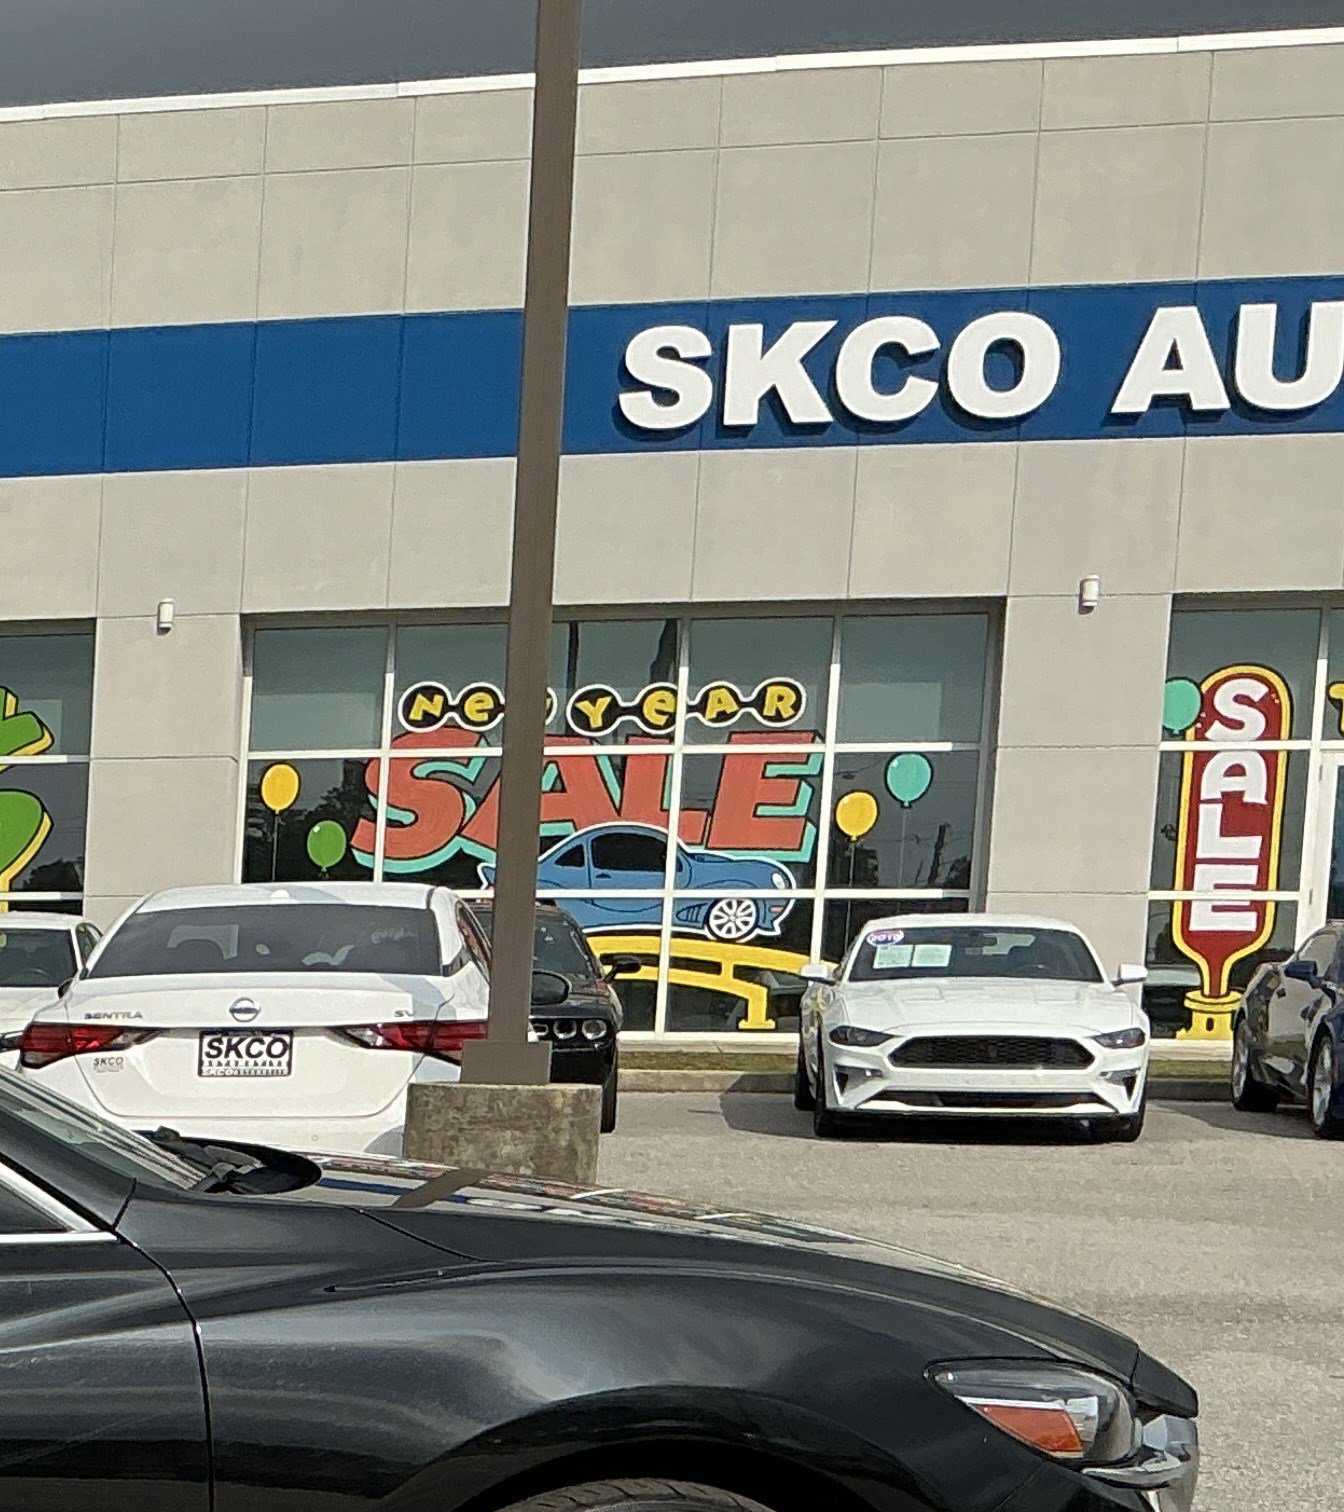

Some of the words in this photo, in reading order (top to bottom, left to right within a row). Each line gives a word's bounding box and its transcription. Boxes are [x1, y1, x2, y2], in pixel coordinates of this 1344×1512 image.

[618, 311, 1061, 431] SKCO
[409, 688, 553, 722] Ne
[351, 726, 816, 866] SALE
[1188, 677, 1269, 932] SALE
[84, 1011, 144, 1020] SENTRA
[204, 1036, 290, 1059] SKCO
